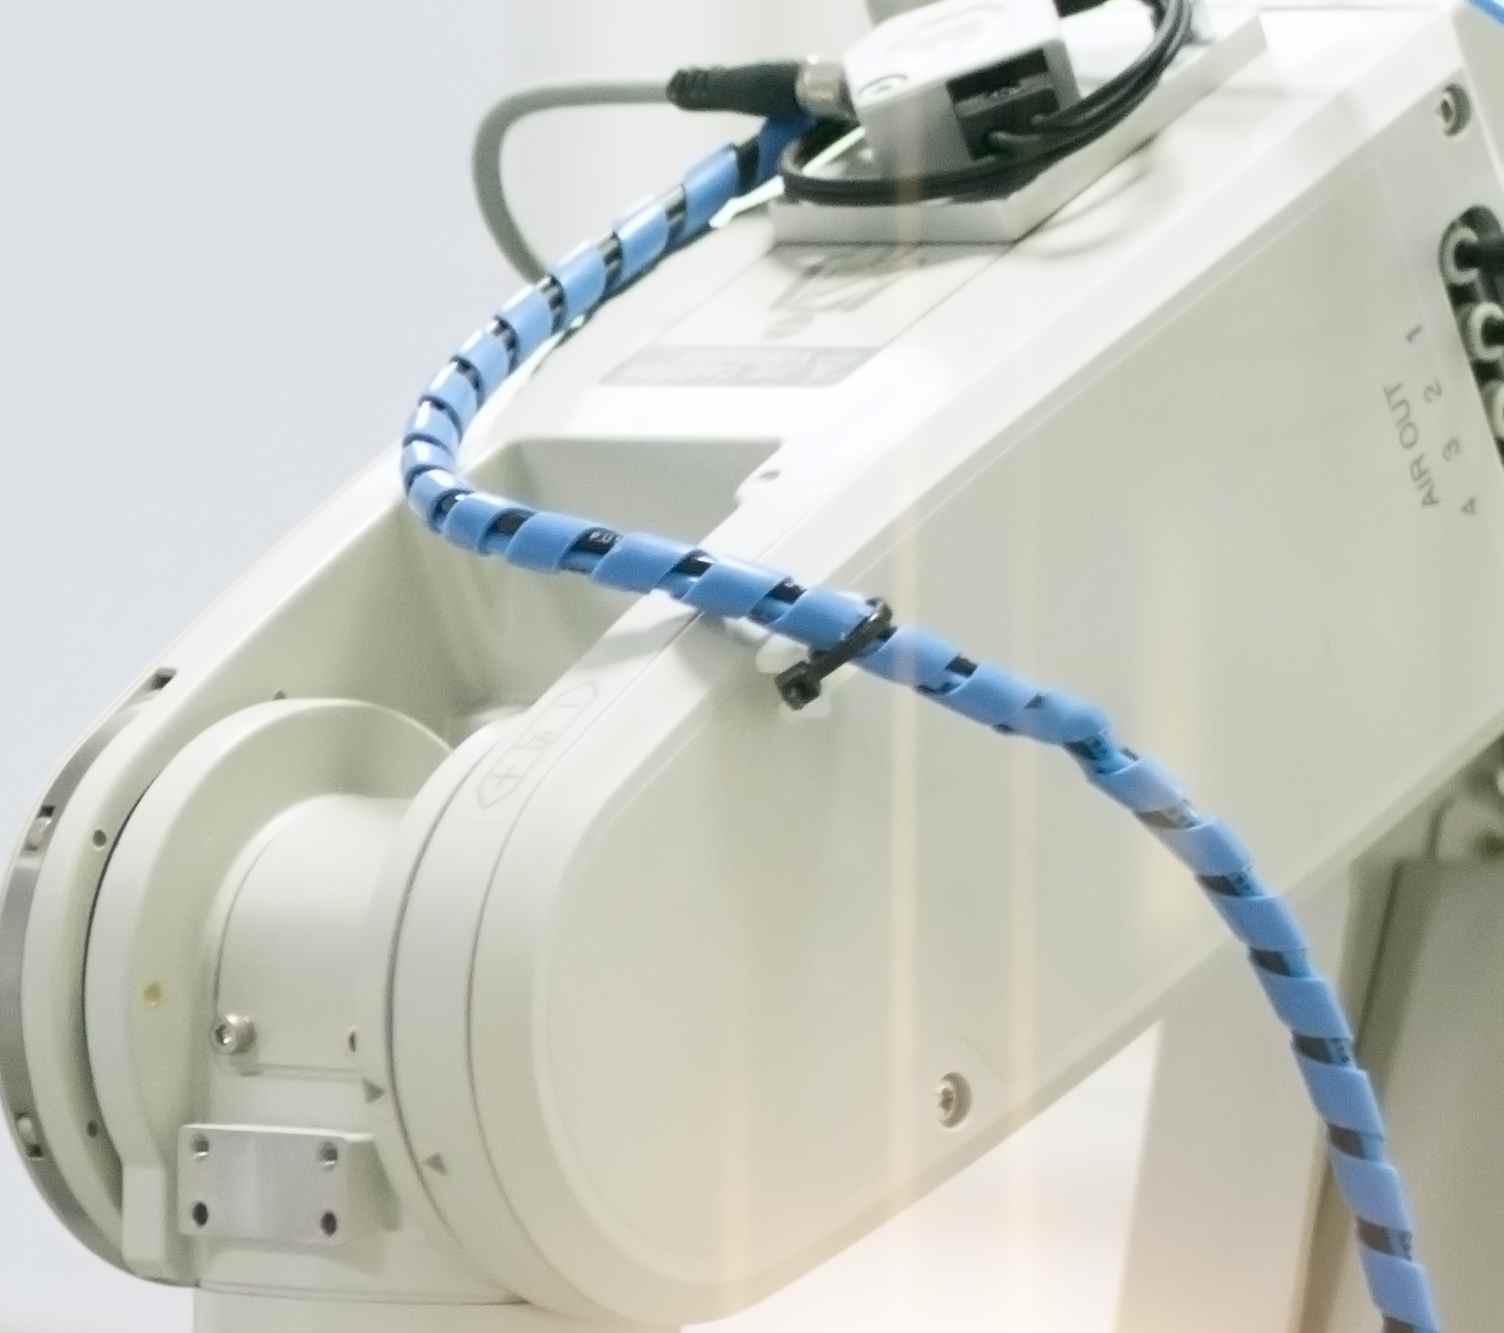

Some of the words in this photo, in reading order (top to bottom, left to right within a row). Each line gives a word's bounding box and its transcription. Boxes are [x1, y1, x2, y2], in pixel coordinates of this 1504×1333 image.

[1405, 325, 1424, 343] 1
[1423, 379, 1443, 403] 2
[1384, 382, 1419, 450] OUT
[1441, 436, 1461, 462] 3
[1409, 453, 1440, 508] AIR
